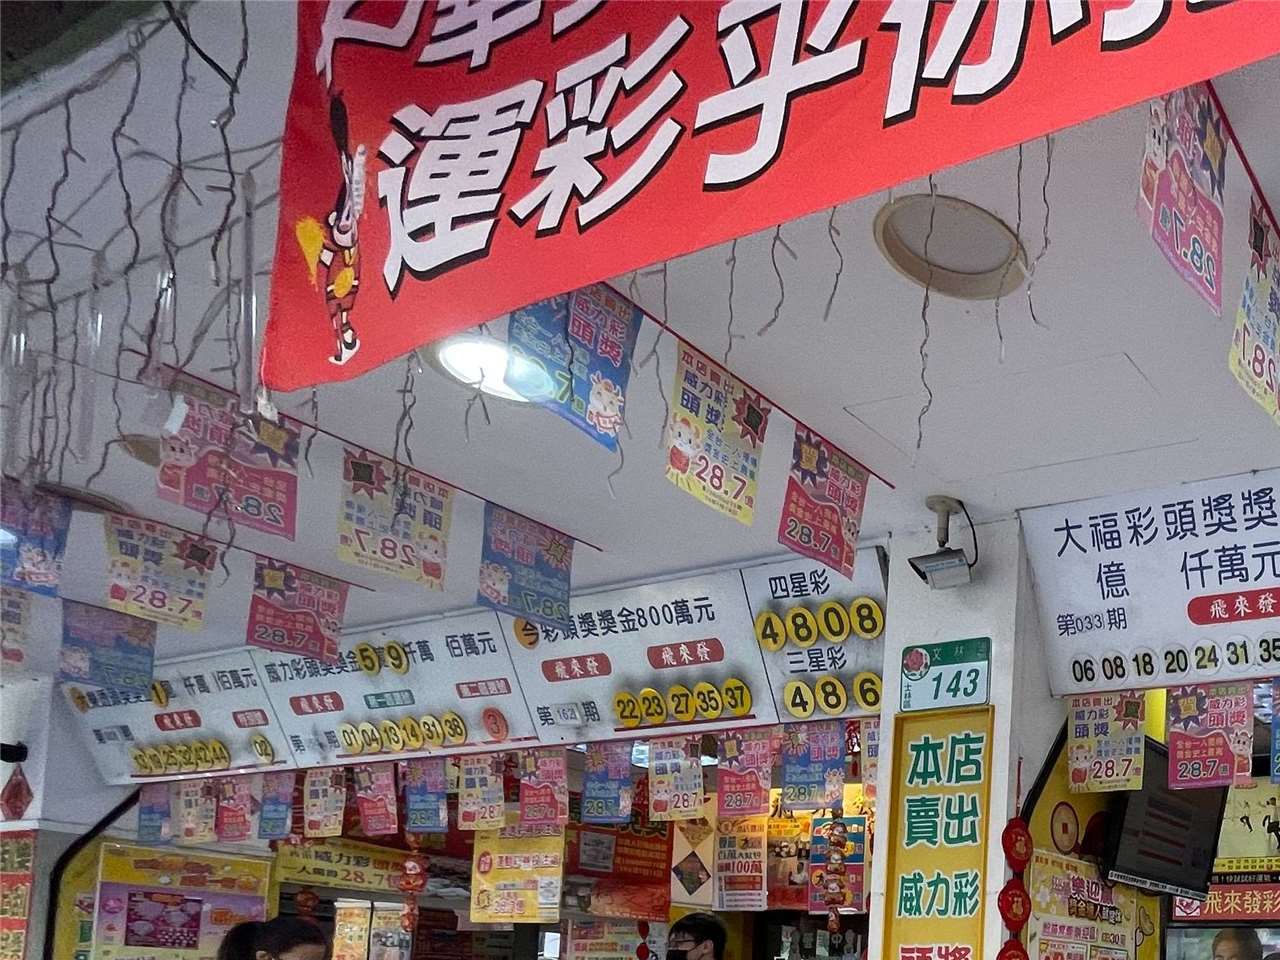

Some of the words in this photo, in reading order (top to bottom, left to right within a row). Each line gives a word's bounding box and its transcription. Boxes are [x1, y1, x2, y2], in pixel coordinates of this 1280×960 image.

[694, 455, 748, 500] 28.7
[770, 569, 831, 601] 四星彩
[1096, 560, 1130, 601] 億
[1209, 592, 1279, 620] 飛來發
[554, 658, 601, 680] 飛來發
[661, 642, 711, 667] 飛來發
[787, 646, 847, 674] 三星彩
[1072, 658, 1096, 683] 06
[1101, 655, 1126, 681] 08
[1132, 652, 1154, 677] 18
[1164, 649, 1189, 674] 20
[1195, 645, 1219, 671] 24
[1226, 641, 1250, 666] 31
[931, 668, 980, 700] 143
[616, 699, 638, 721] 22
[642, 697, 664, 718] 23
[671, 693, 692, 715] 27
[697, 689, 719, 713] 35
[724, 685, 746, 710] 37
[907, 732, 985, 786] 本店
[1092, 758, 1133, 779] 28.7
[1178, 759, 1219, 780] 28.7
[904, 794, 979, 847] 賣出
[897, 870, 980, 918] 威力彩
